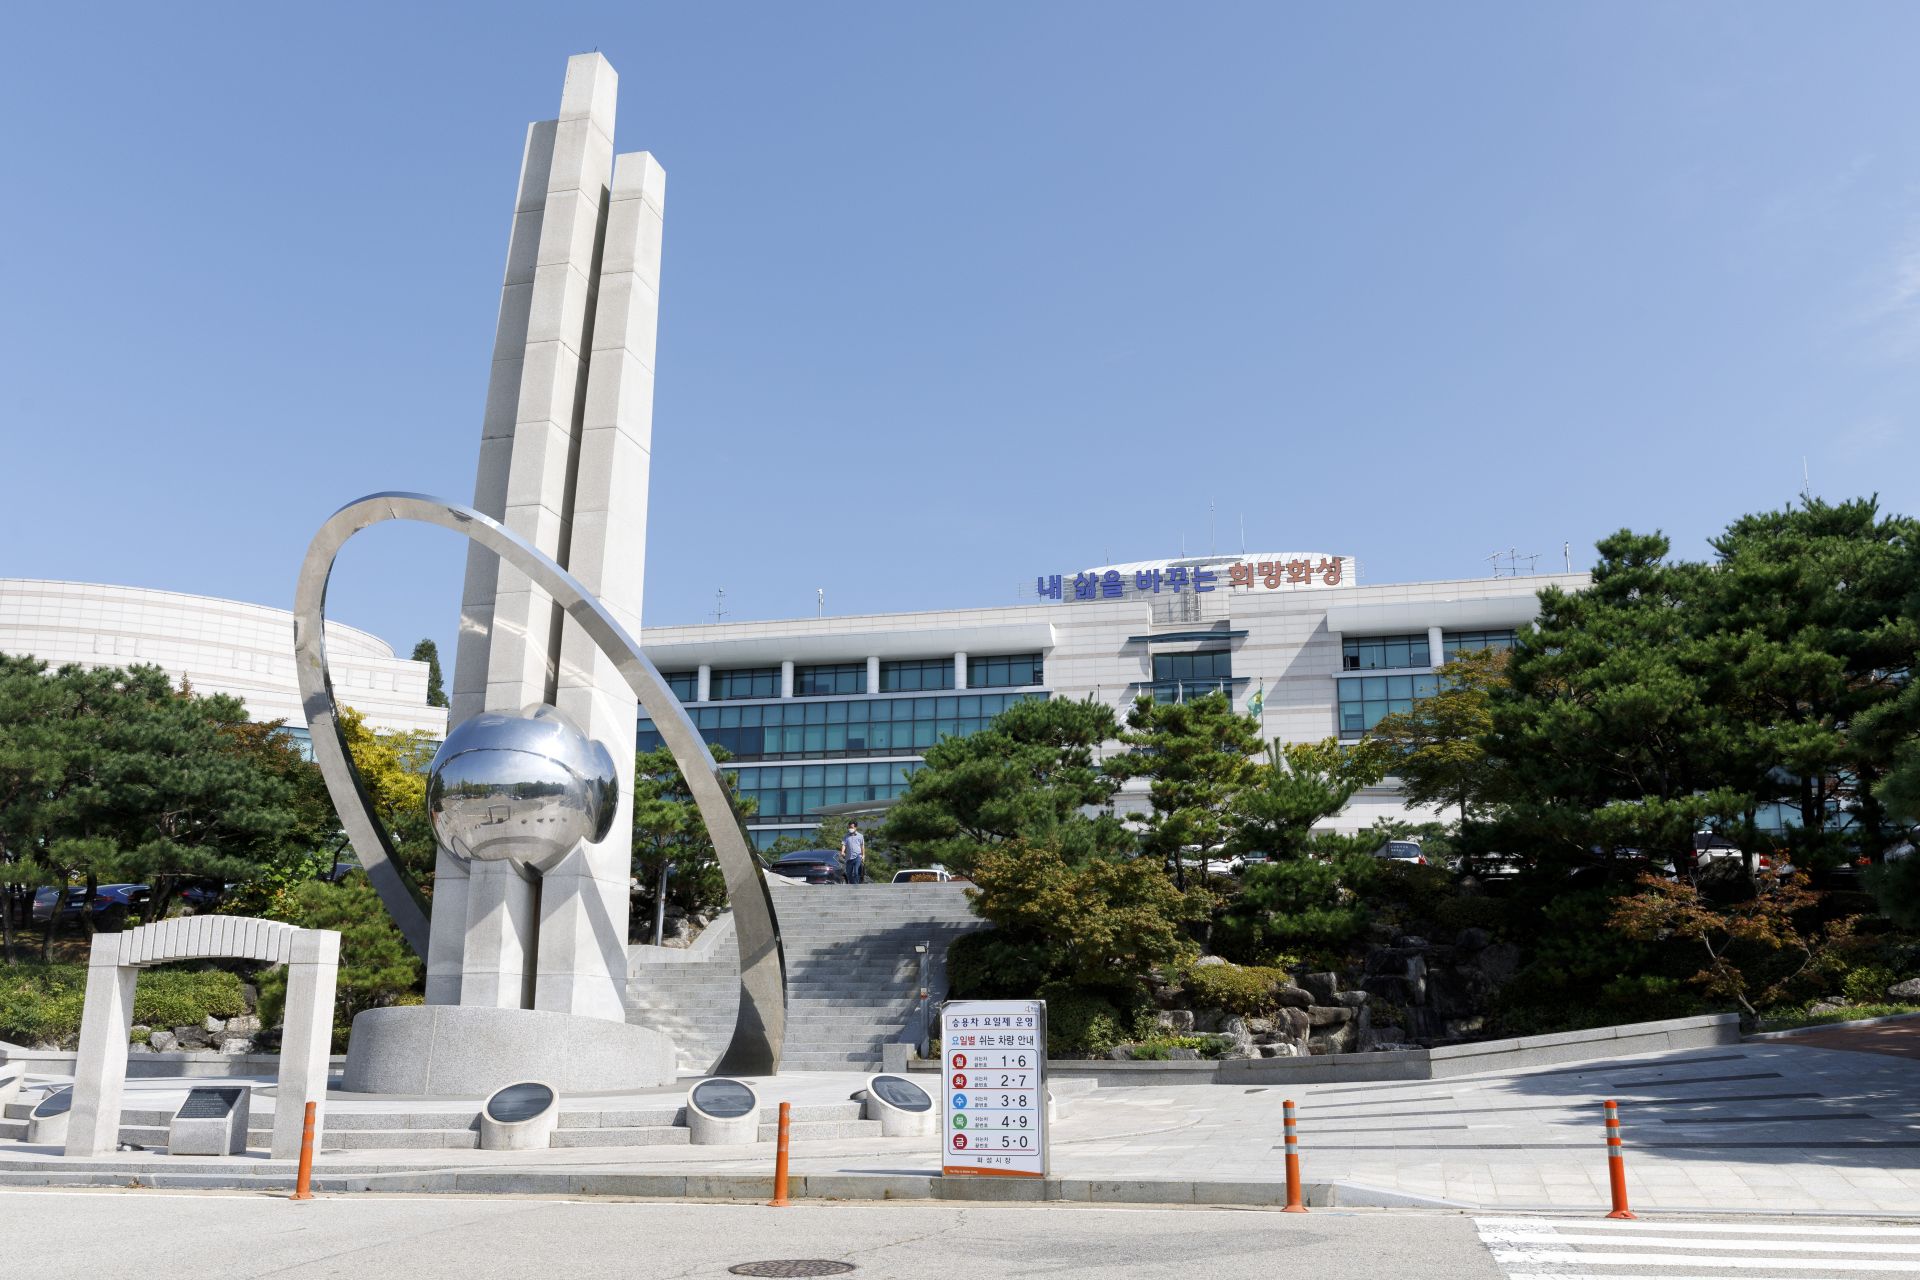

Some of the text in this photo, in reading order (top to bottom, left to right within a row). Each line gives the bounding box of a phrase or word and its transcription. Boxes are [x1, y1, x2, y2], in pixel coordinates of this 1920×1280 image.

[1038, 556, 1342, 600] 내 삶을 바꾸는 희망화성
[952, 1016, 1033, 1028] 승용차 요일제 운영
[952, 1035, 1034, 1046] 요일별 쉬는 차량 안내
